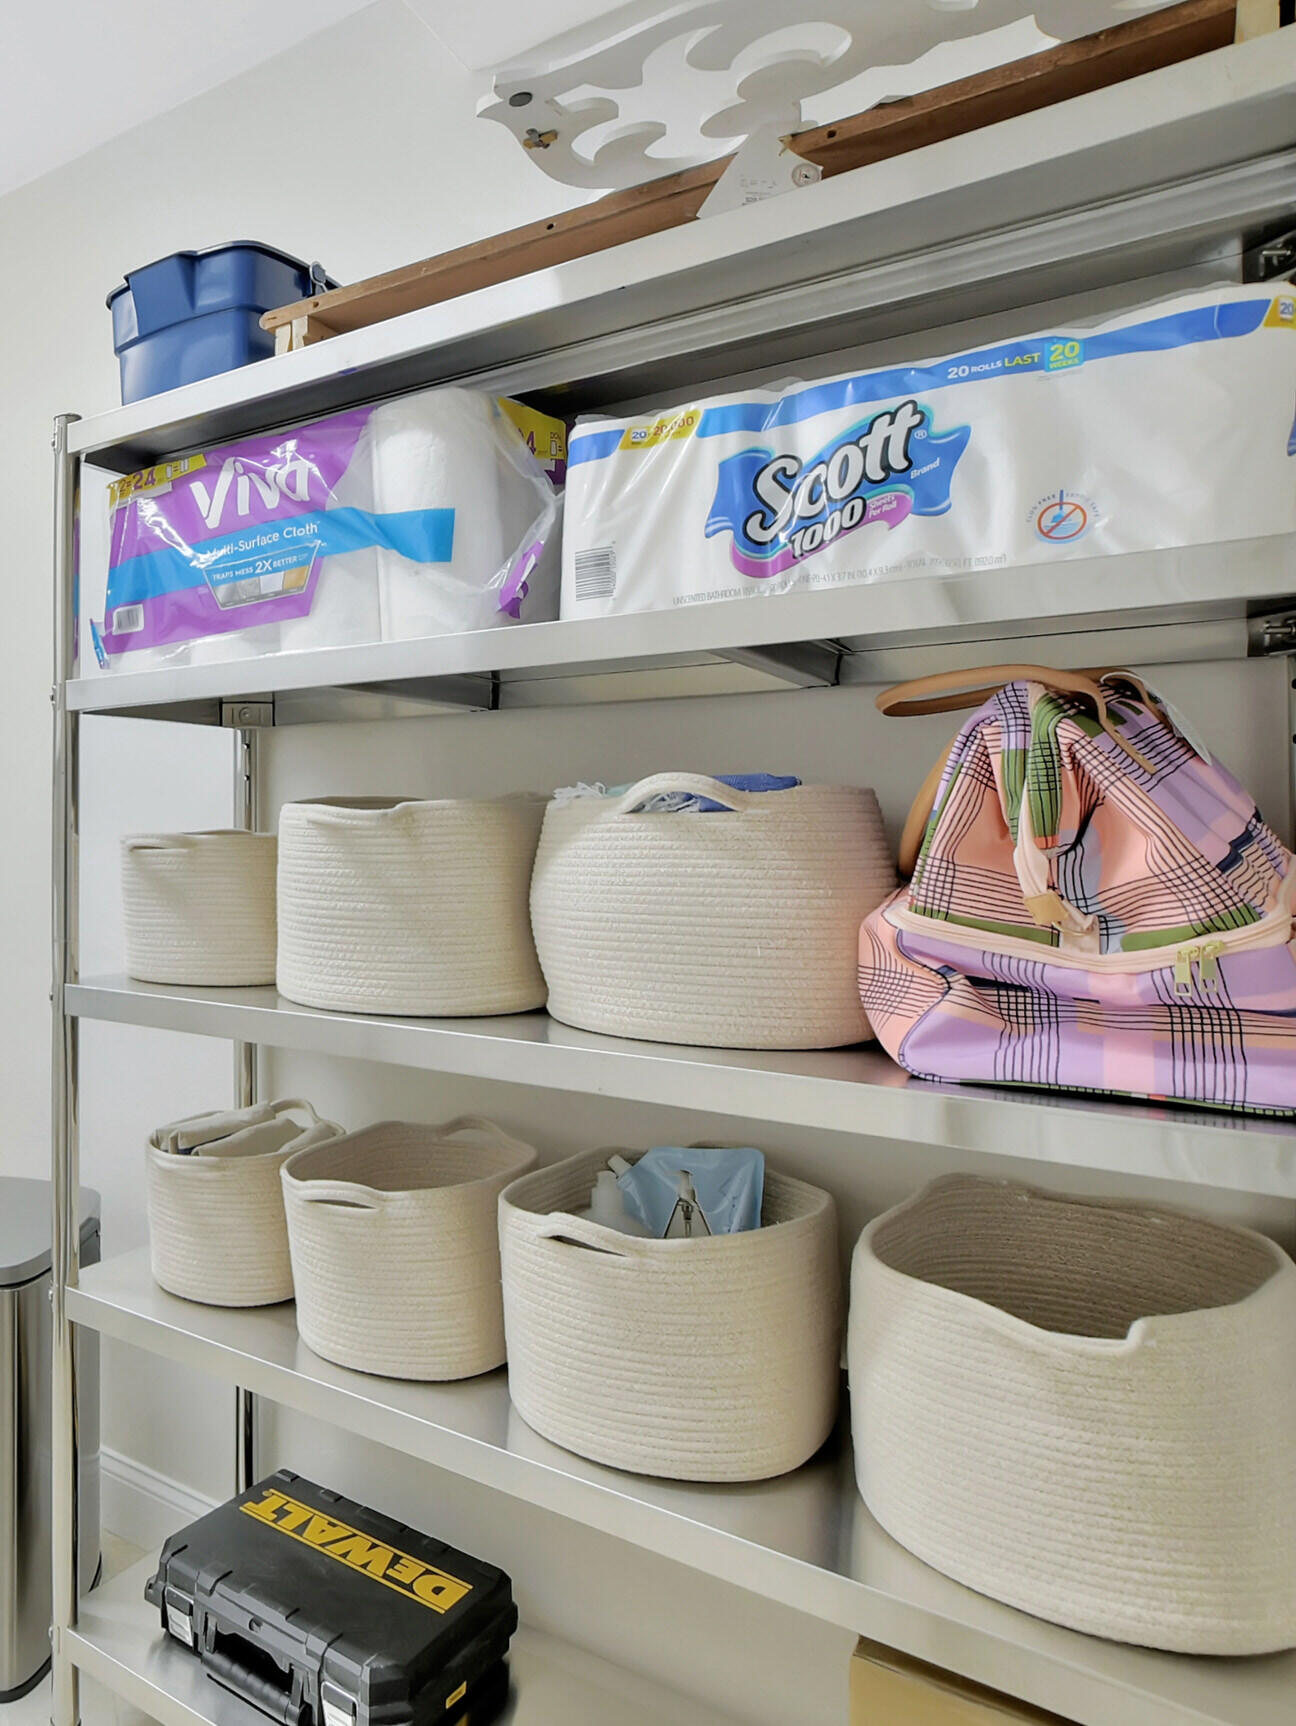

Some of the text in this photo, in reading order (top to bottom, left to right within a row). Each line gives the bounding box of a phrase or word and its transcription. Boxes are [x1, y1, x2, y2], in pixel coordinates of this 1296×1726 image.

[947, 341, 1081, 379] 20 ROLLS LAST 20
[631, 431, 648, 440] 20
[189, 456, 310, 529] Viva
[743, 400, 924, 545] Scott
[910, 457, 940, 479] Brand
[790, 497, 866, 559] 1000
[254, 558, 273, 573] 2X
[242, 1493, 470, 1610] DEWALT
